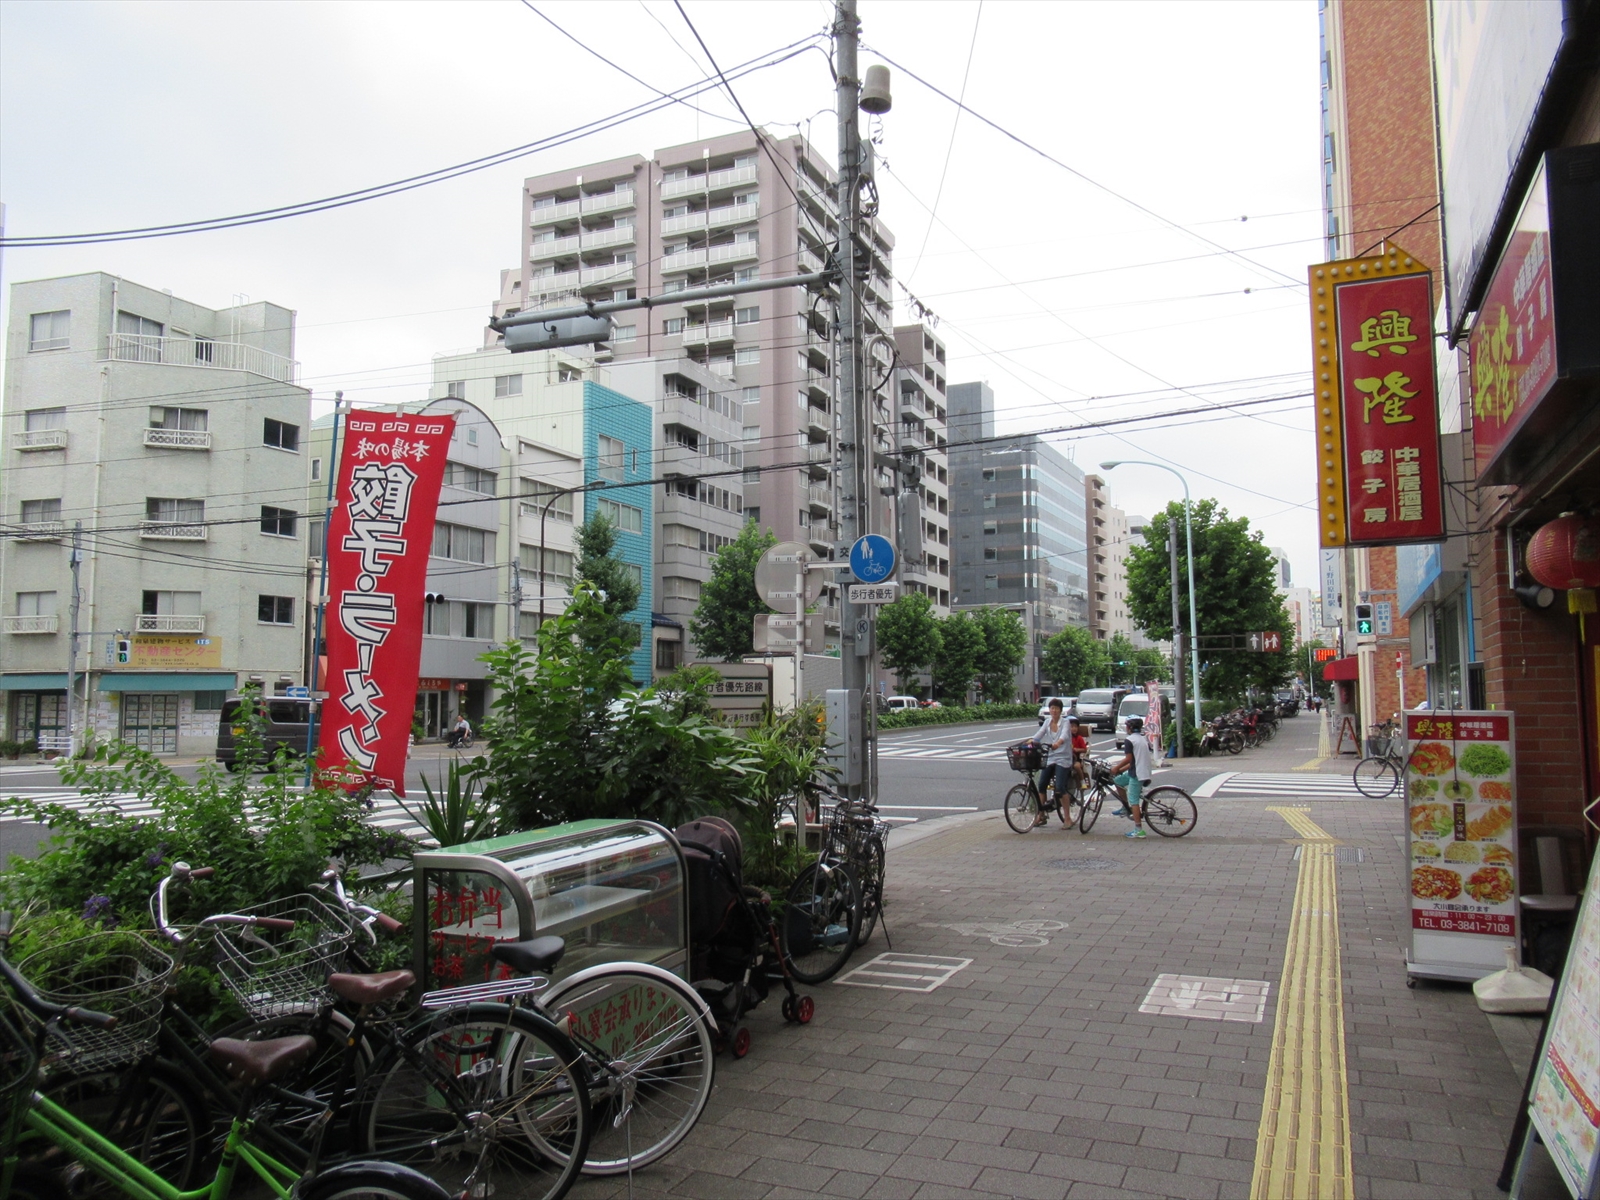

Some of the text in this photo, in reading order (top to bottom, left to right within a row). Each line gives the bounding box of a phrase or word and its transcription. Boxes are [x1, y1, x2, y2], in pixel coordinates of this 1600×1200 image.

[1350, 310, 1419, 425] 興隆
[1360, 449, 1388, 523] 餃子房
[1394, 446, 1423, 521] 中華居酒屋
[851, 587, 893, 600] 歩行者優先
[134, 645, 217, 657] 不動産センター
[705, 681, 763, 693] 行者優先路線
[431, 886, 503, 930] お弁当
[1419, 917, 1510, 933] TEL. 03-3841-7109
[432, 954, 465, 980] お茶
